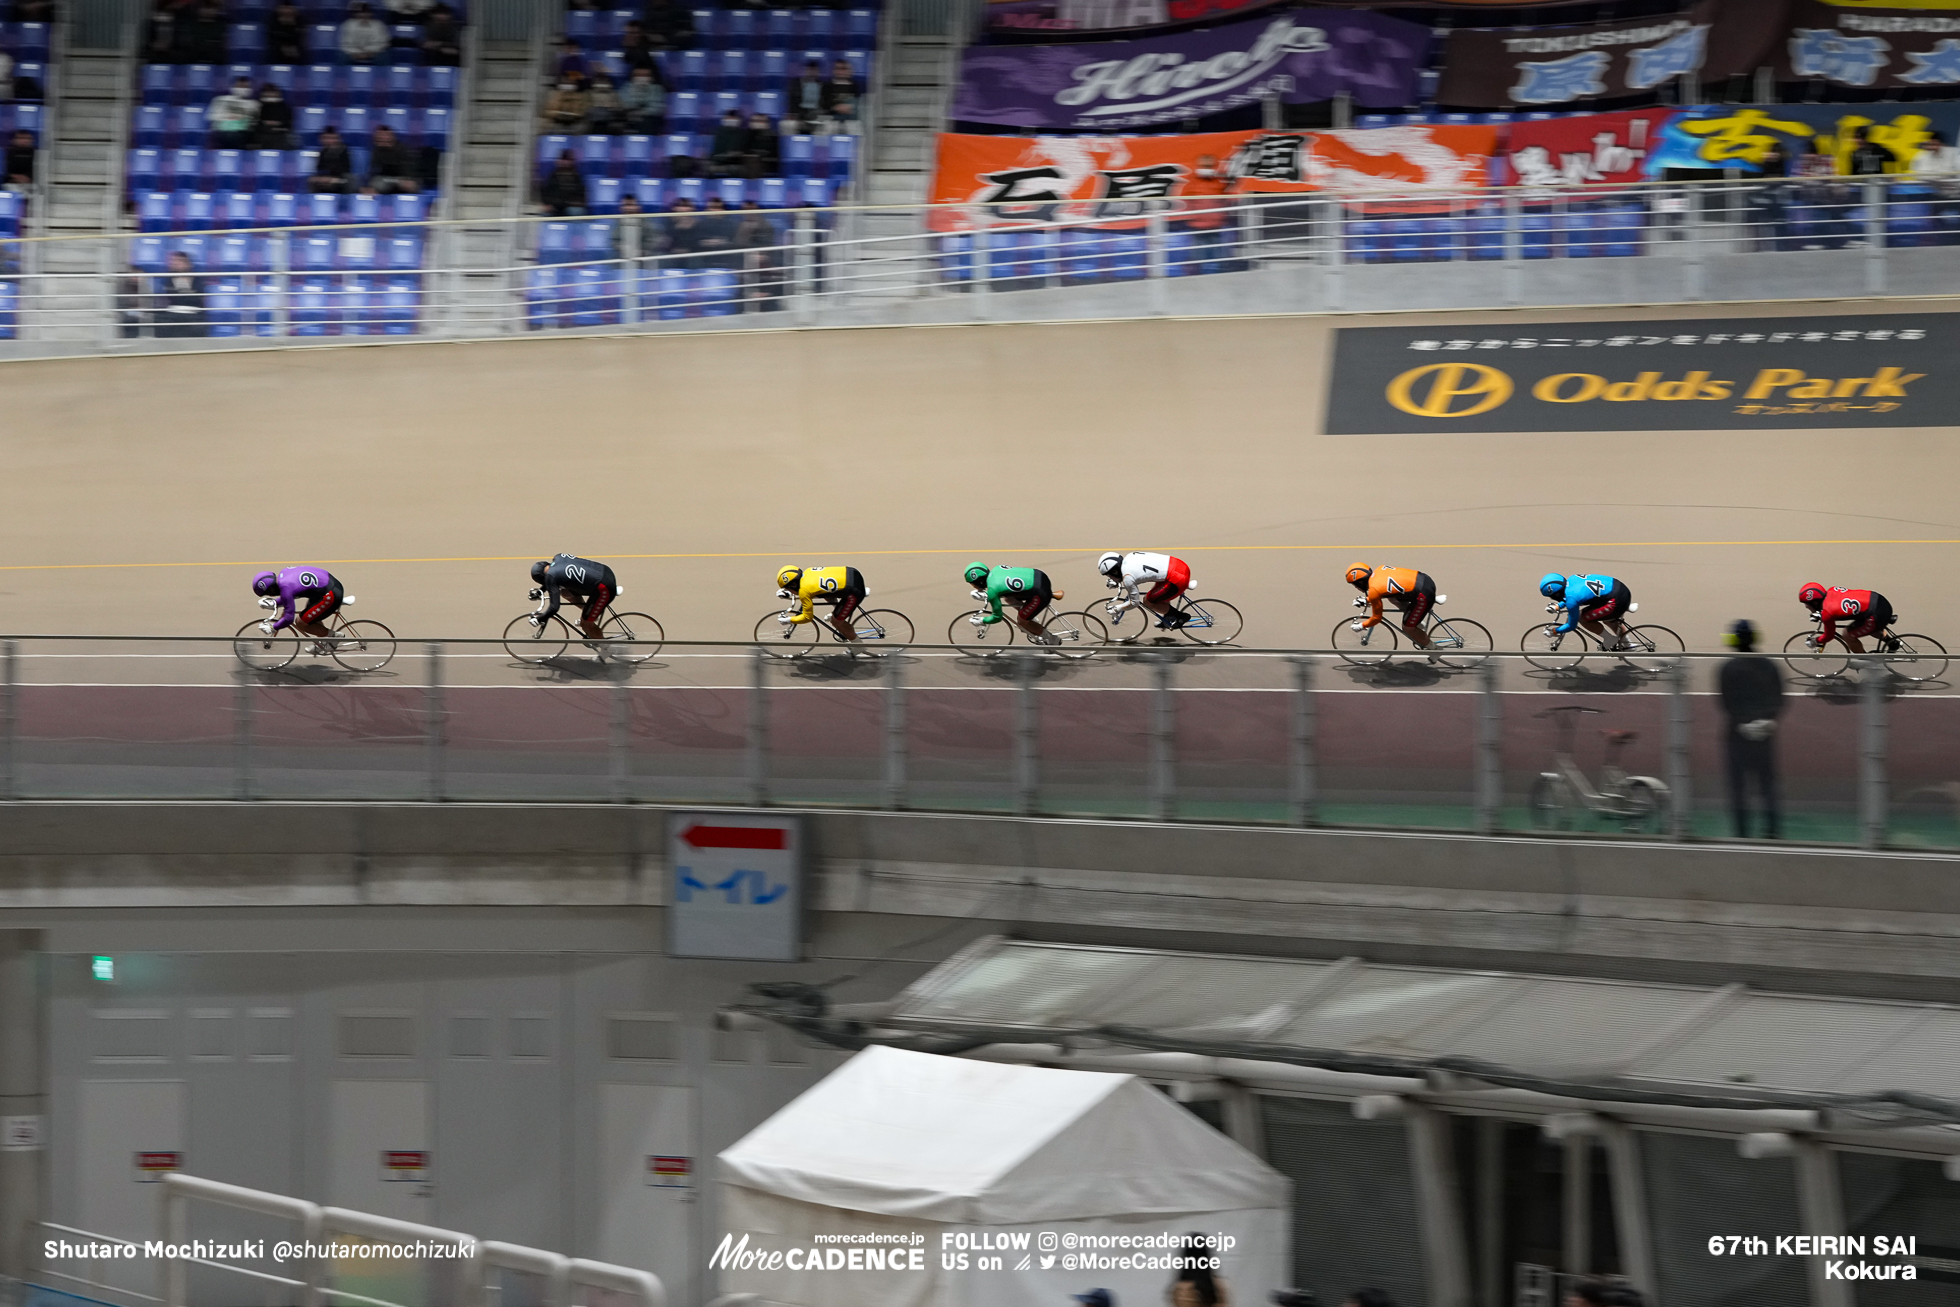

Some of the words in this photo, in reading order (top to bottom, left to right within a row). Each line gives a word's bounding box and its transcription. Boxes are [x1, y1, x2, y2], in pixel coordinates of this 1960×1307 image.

[1531, 371, 1735, 403] Odds
[1742, 366, 1928, 399] Park
[565, 563, 586, 584] 2
[970, 570, 978, 580] 6
[1142, 564, 1159, 574] 1
[299, 571, 318, 587] 9
[782, 573, 788, 583] 5
[820, 577, 838, 592] 5
[1005, 576, 1025, 592] 6
[1387, 576, 1405, 594] 7
[1585, 579, 1605, 597] 4
[1806, 590, 1814, 600] 3
[1841, 598, 1860, 615] 3
